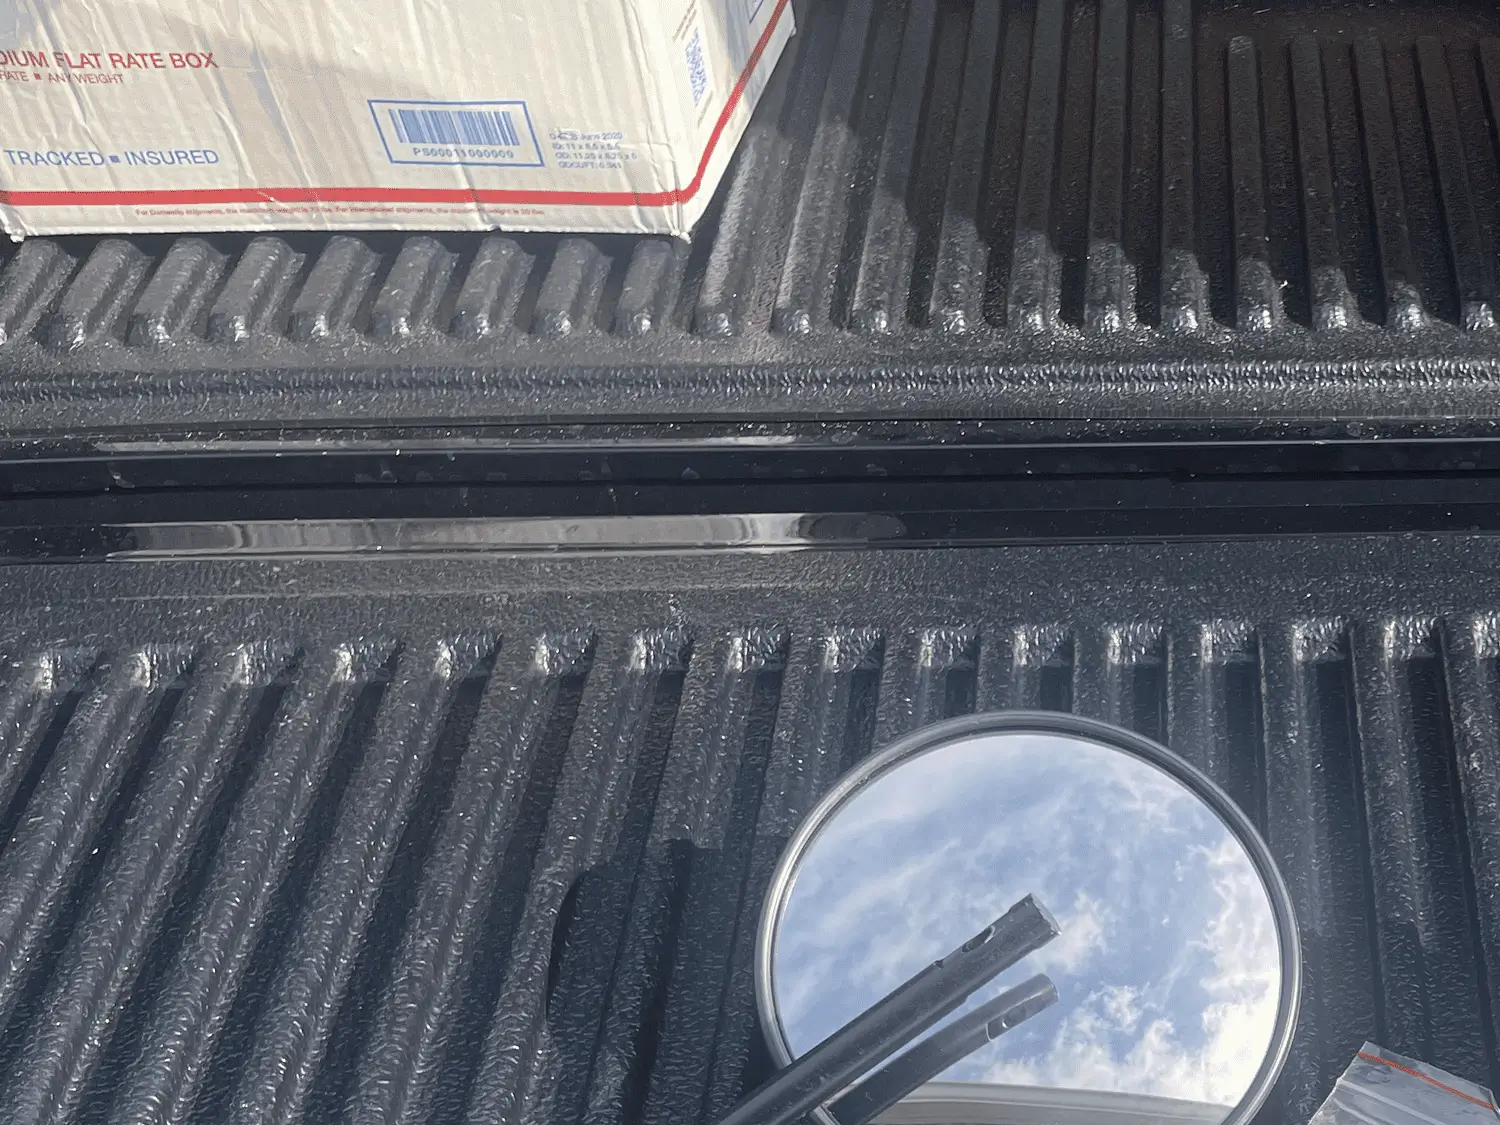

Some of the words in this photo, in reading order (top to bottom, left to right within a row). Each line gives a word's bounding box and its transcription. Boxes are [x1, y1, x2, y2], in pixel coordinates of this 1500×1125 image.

[52, 52, 101, 69] FLAT
[107, 52, 166, 69] RATE
[168, 52, 219, 69] BOX
[0, 70, 29, 82] RATE
[48, 72, 73, 84] ANY
[74, 73, 124, 84] WEIGHT
[4, 149, 105, 166] TRACKED
[123, 150, 220, 166] INSURED
